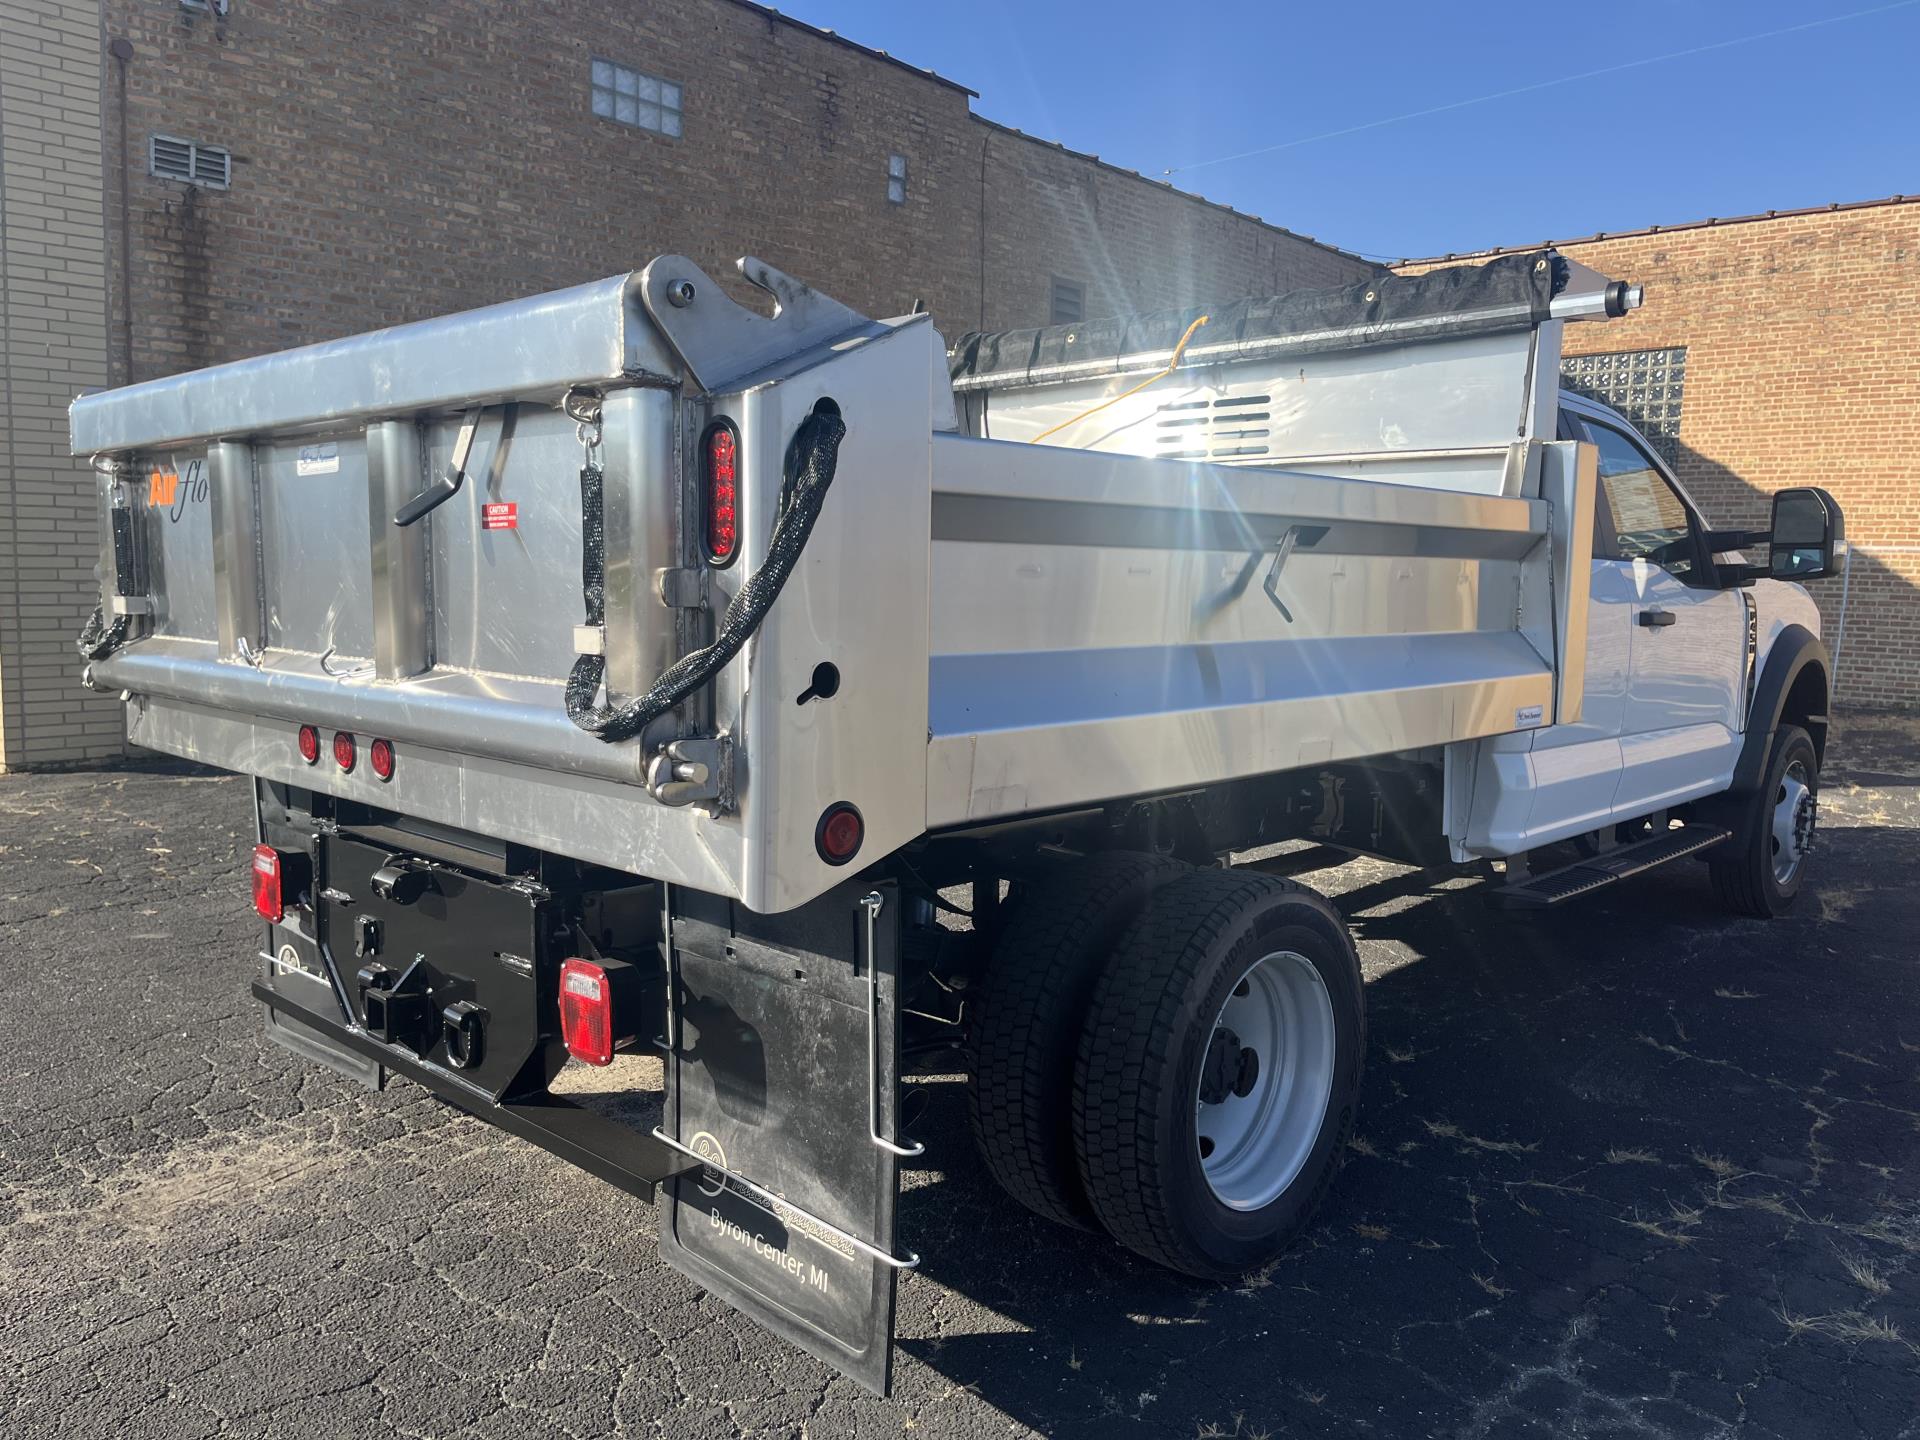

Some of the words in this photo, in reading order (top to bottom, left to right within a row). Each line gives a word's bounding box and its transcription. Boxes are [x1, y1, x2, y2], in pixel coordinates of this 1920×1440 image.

[489, 504, 509, 514] CAUTION
[710, 1206, 751, 1248] Byron
[754, 1233, 806, 1285] Center,
[810, 1264, 829, 1294] MI
